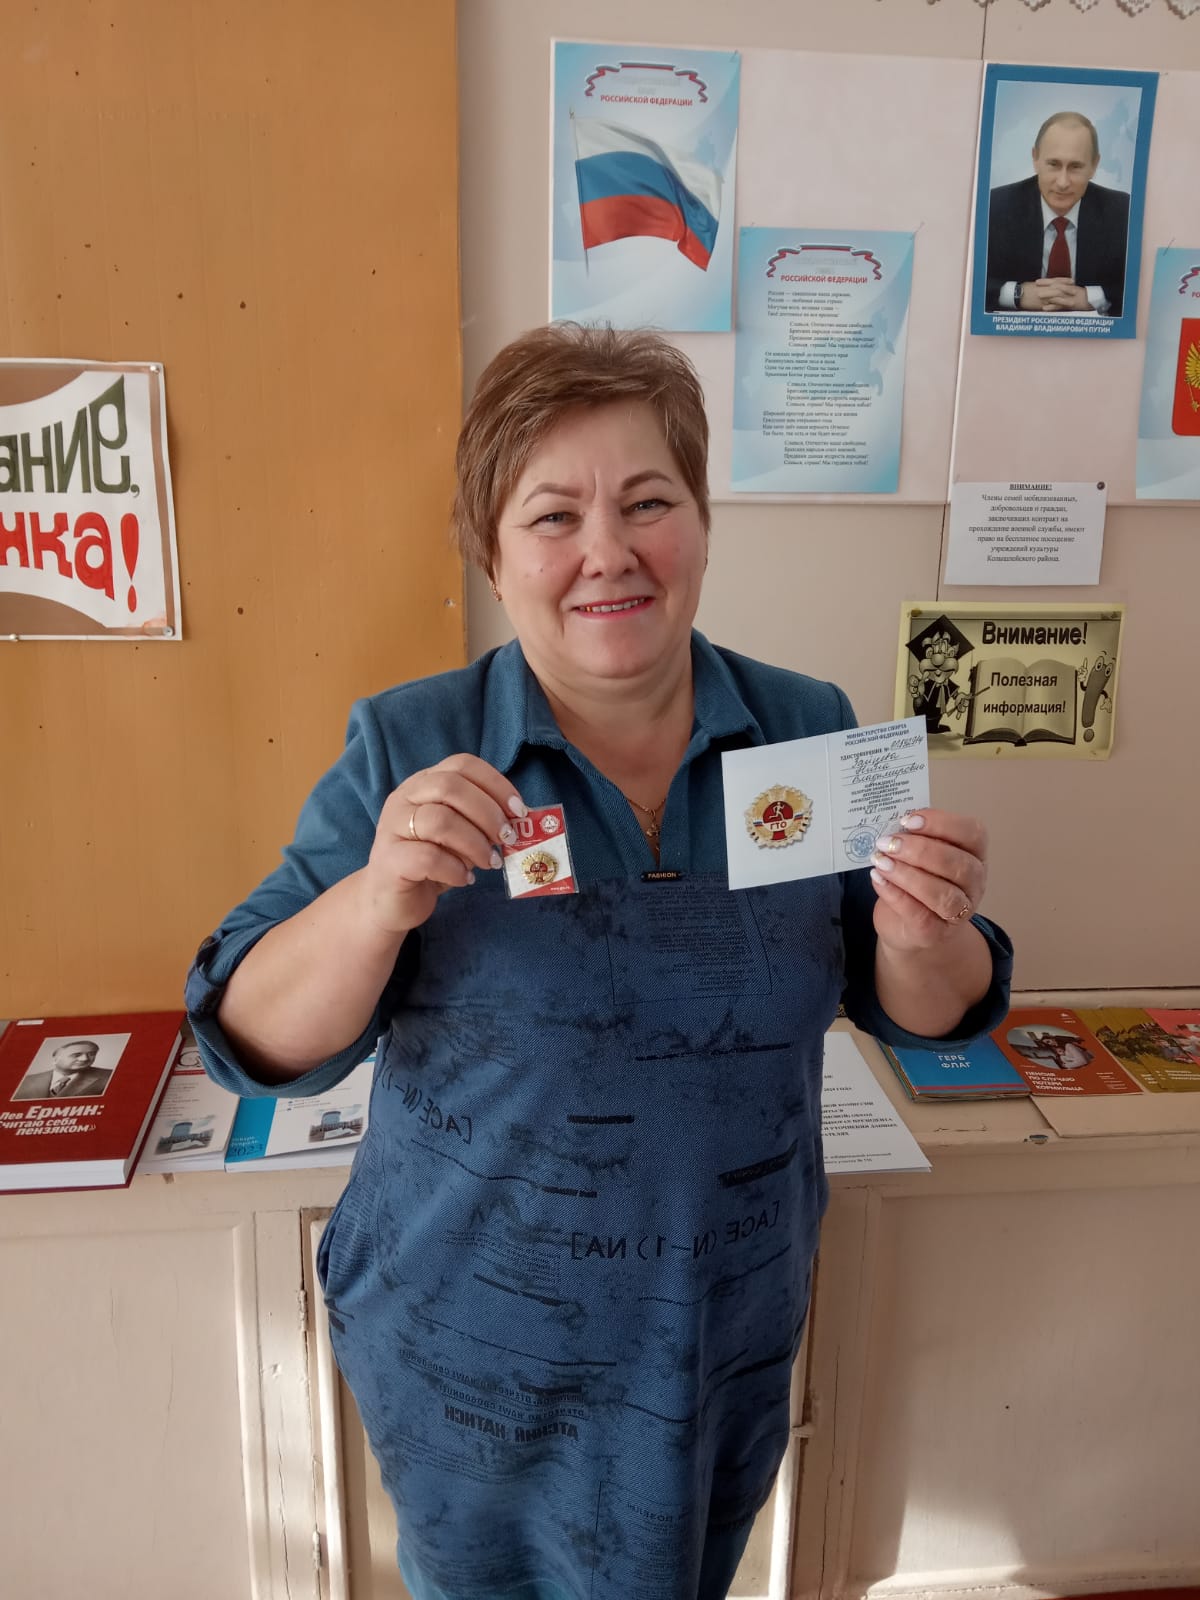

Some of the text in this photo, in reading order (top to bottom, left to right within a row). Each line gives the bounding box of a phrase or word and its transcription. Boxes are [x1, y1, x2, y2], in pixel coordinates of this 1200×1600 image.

[600, 94, 693, 107] РОССИЙСКОЙ ФЕДЕРАЦИИ
[780, 274, 868, 284] РОССИЙСКОЙ ФЕДЕРАЦИИ
[992, 316, 1114, 327] ПРЕЗИДЕНТ РОССИЙСКОЙ ФЕДЕРАЦИИ
[1033, 325, 1088, 333] ВЛАДИМИРОВИЧ
[1089, 326, 1111, 334] ПУТИН
[982, 621, 1088, 645] Внимание!
[990, 672, 1058, 687] Полезная
[983, 700, 1066, 714] информация!
[770, 821, 787, 831] ГТО
[647, 871, 677, 879] FASHION
[0, 1105, 105, 1120] Лев Ермин:
[46, 1117, 77, 1127] себя
